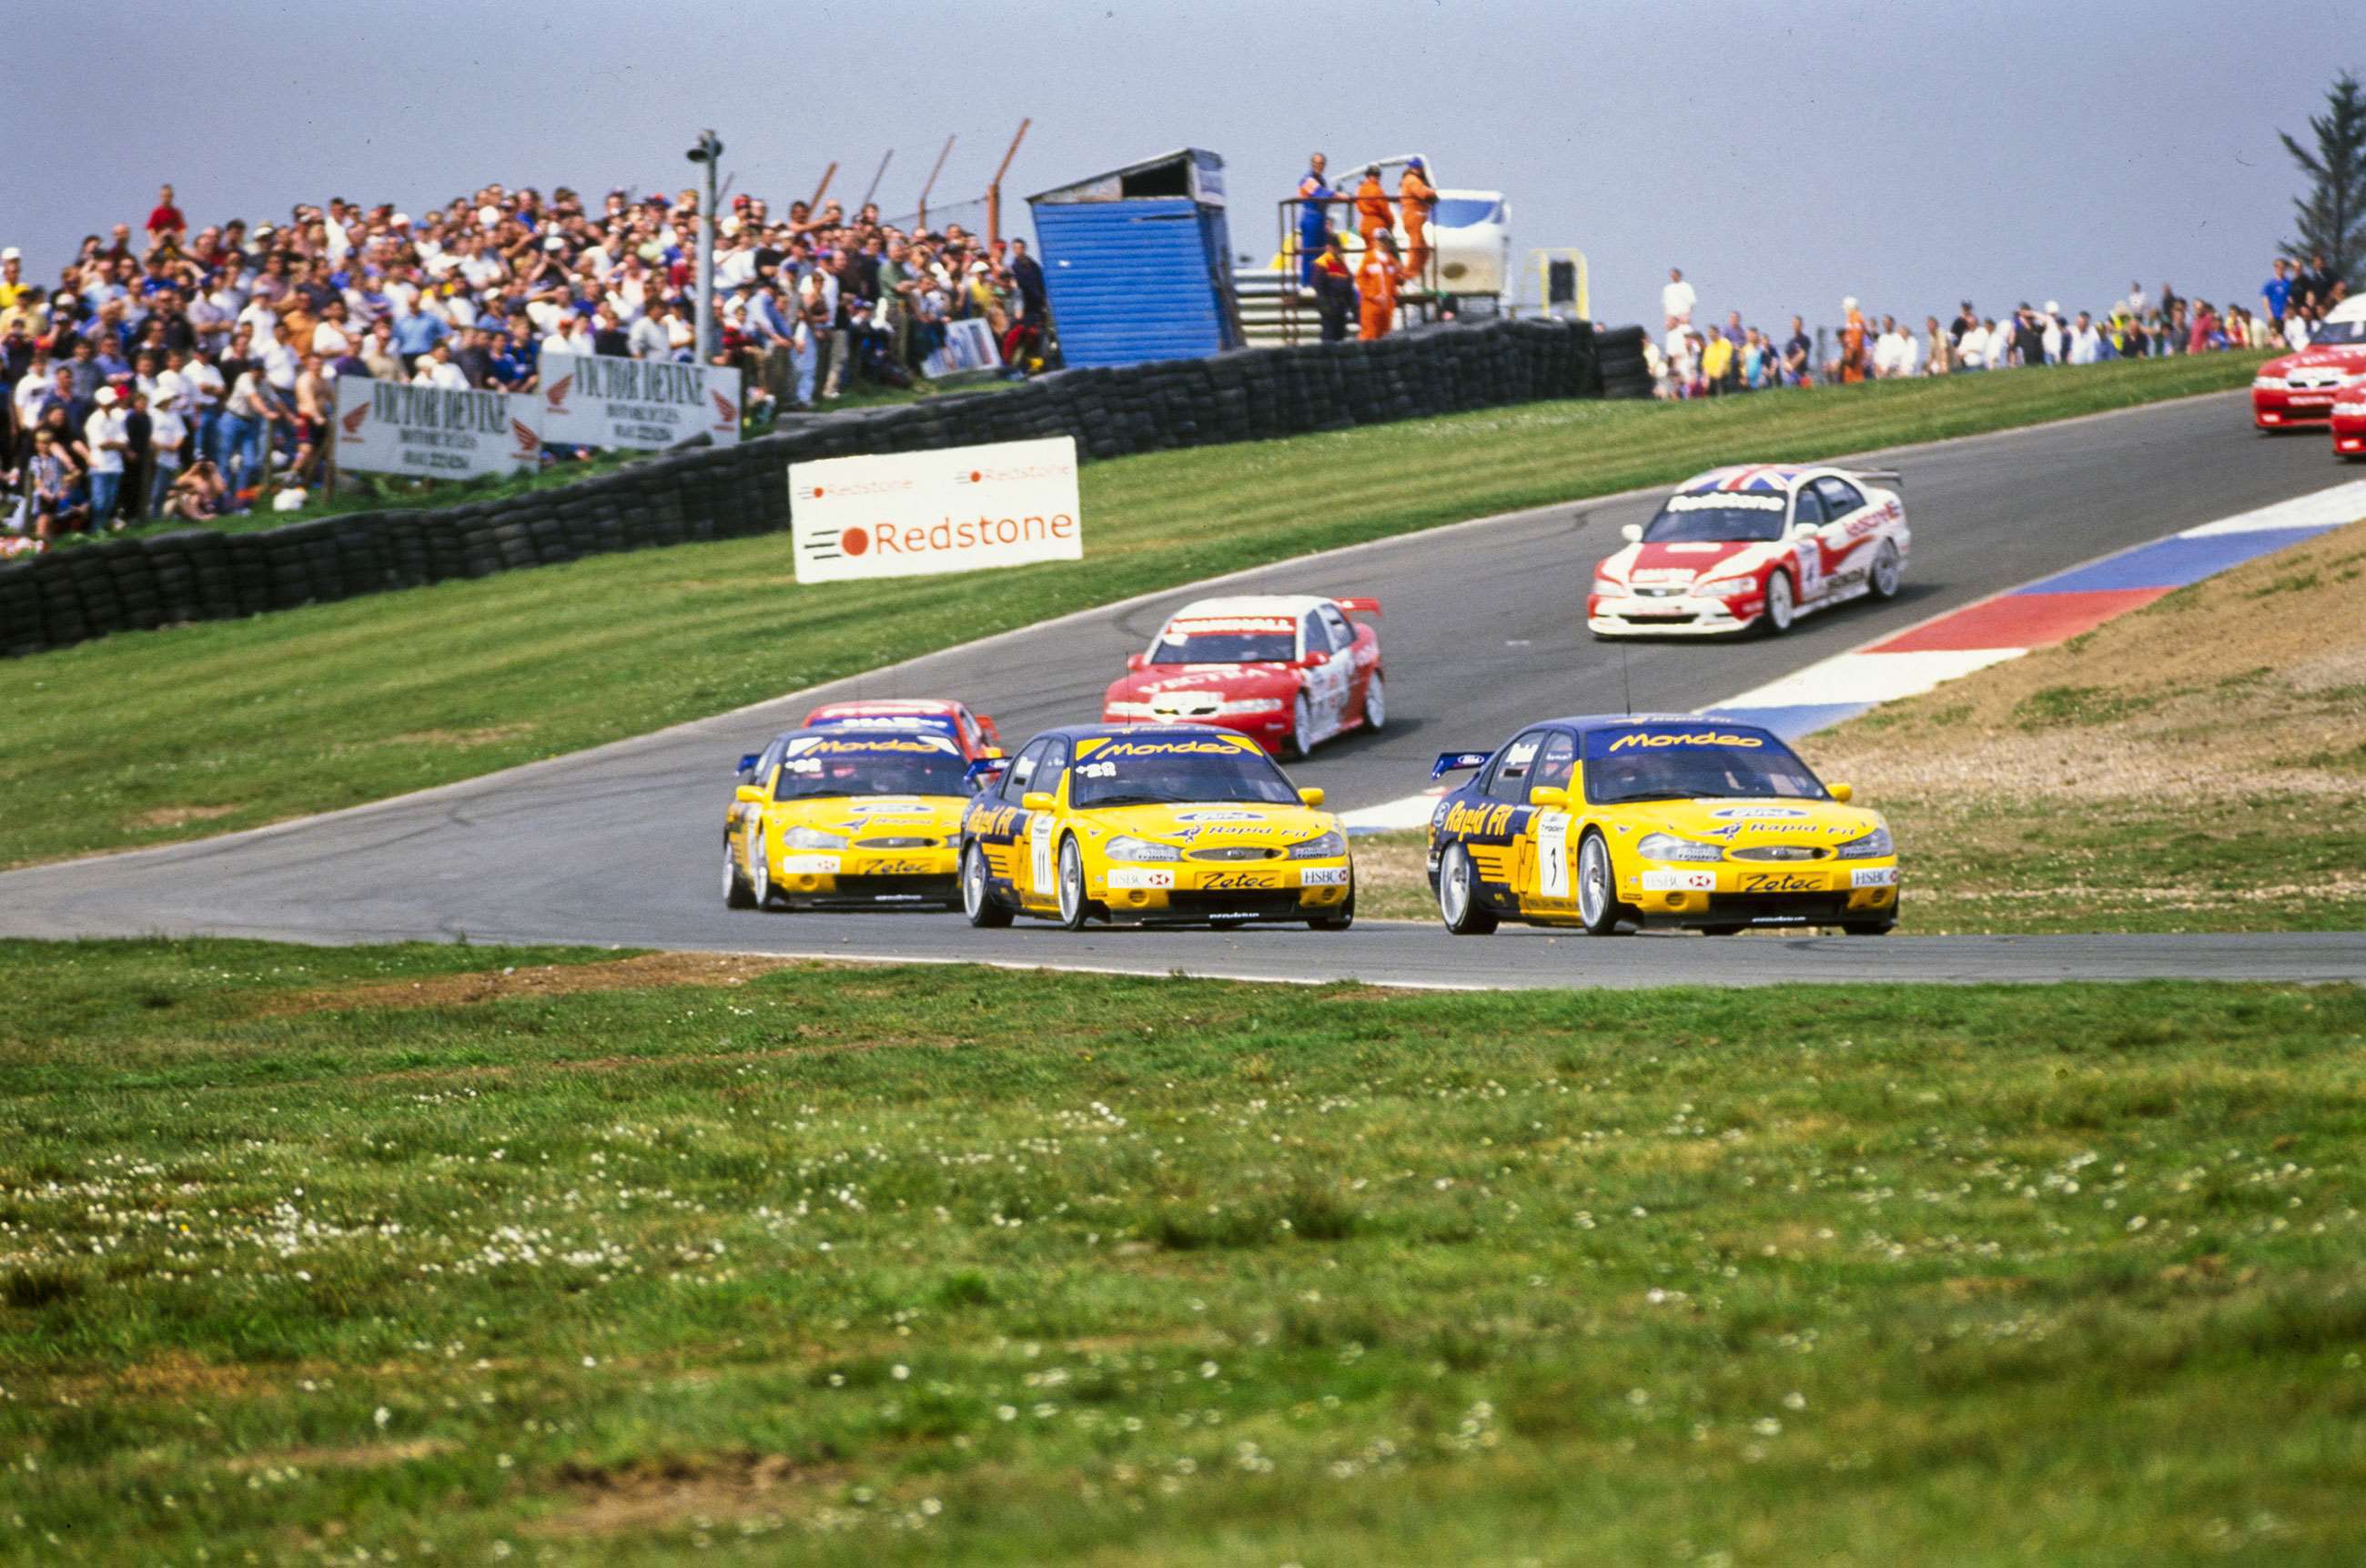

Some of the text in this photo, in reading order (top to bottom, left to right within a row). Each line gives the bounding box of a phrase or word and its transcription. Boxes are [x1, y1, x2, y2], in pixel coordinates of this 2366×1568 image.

[875, 512, 1074, 554] Redstone
[802, 738, 940, 757] Mondeo
[1095, 740, 1242, 760] Mondeo
[1609, 732, 1763, 752] Mondeo
[1443, 801, 1516, 842] Rapid Fit
[1202, 873, 1277, 889] Zetec
[1305, 869, 1339, 884] HSBC
[1744, 874, 1824, 892] Zetec
[1855, 870, 1887, 885] HSBC
